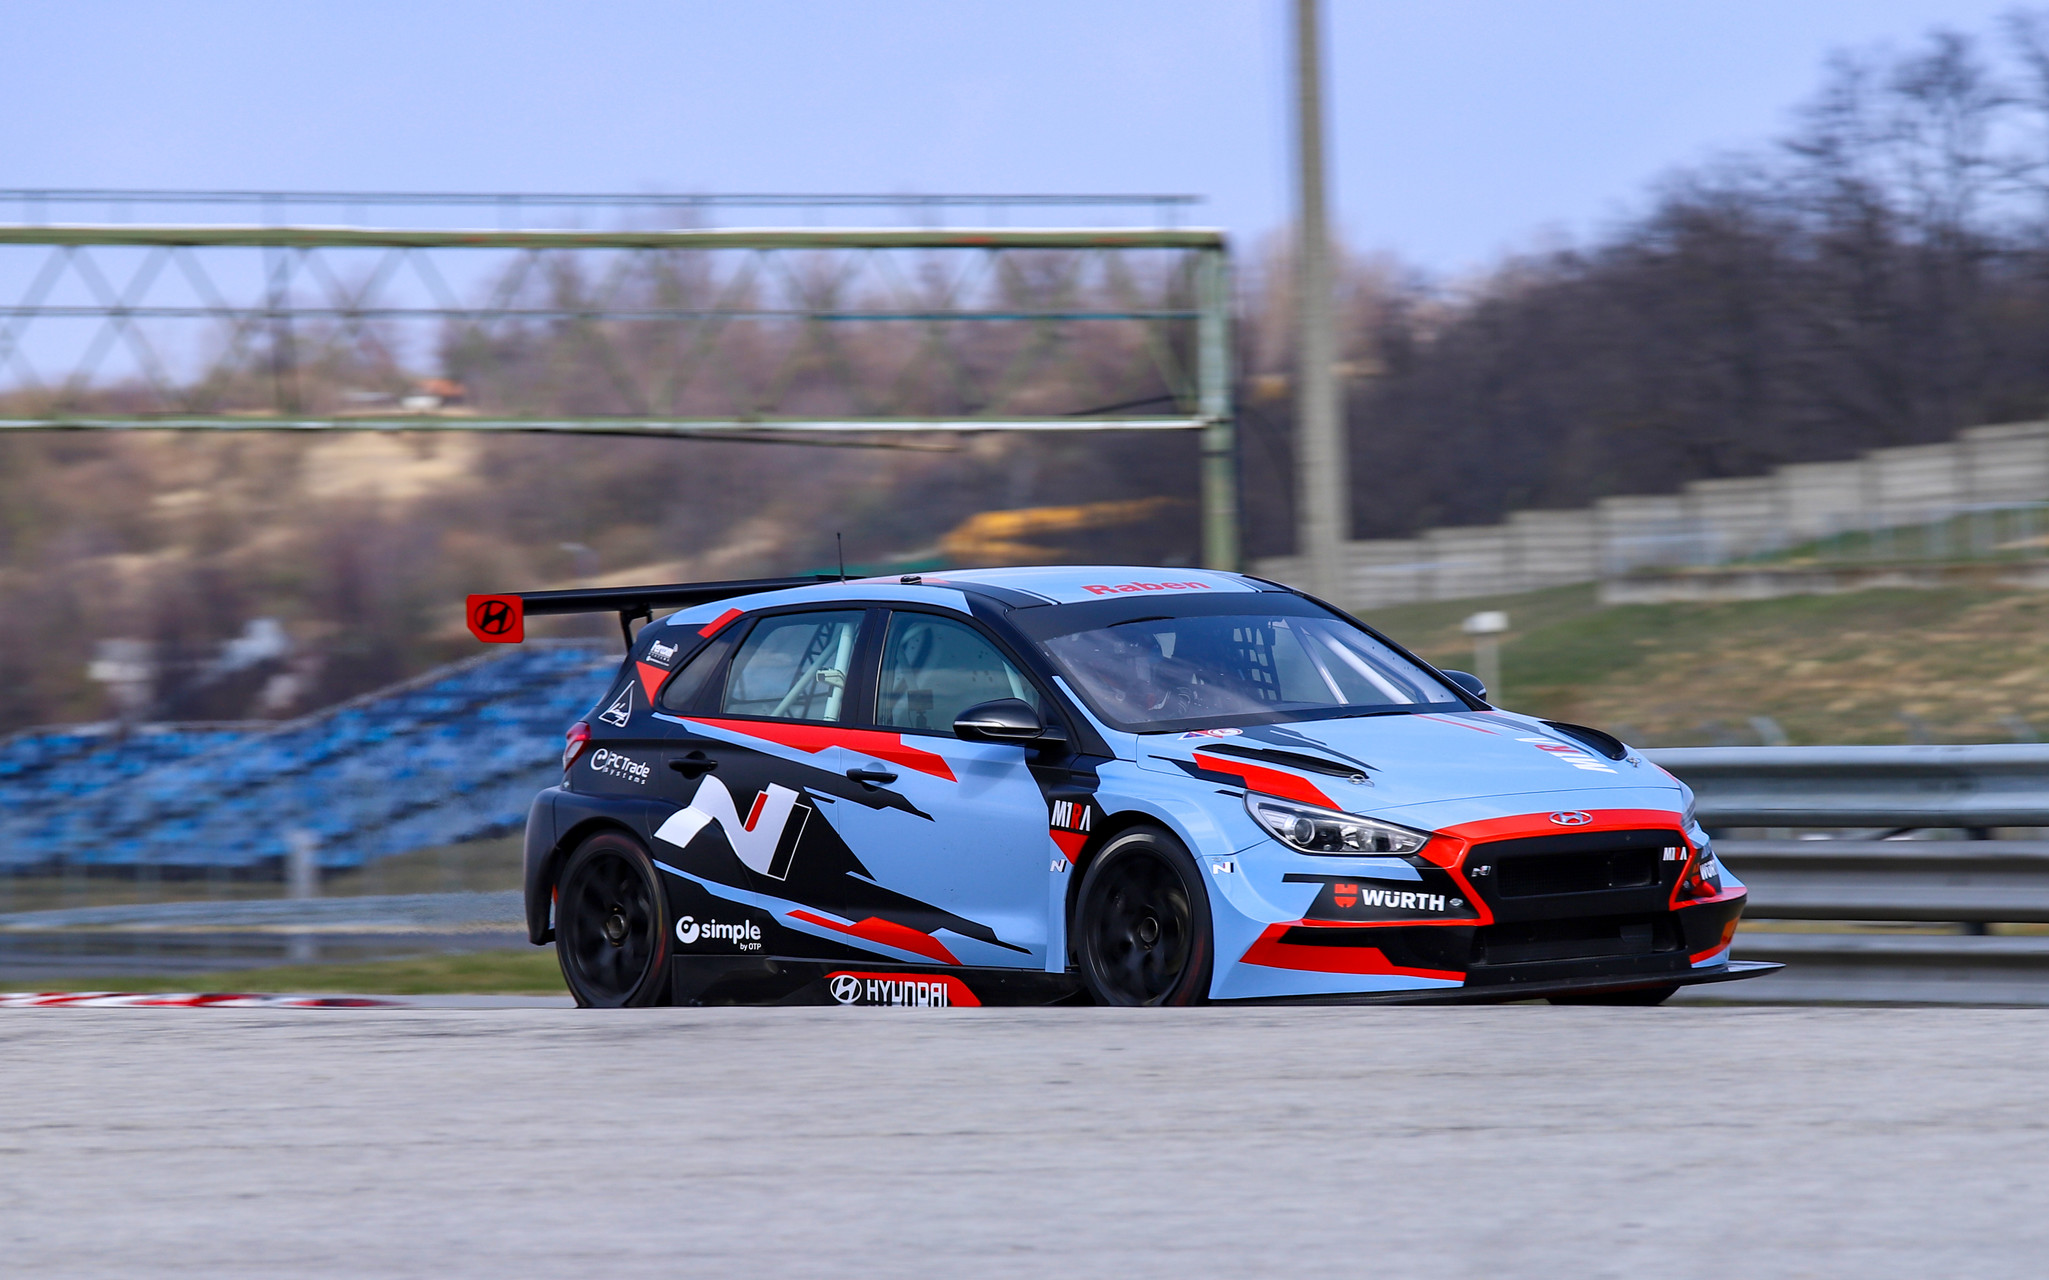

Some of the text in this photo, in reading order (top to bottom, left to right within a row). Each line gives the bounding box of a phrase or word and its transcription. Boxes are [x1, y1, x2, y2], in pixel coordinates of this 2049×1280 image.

[1081, 581, 1211, 595] Raben
[653, 774, 812, 881] N
[1361, 889, 1446, 912] WÜRTH
[701, 918, 762, 945] simple
[739, 942, 762, 952] by OTP
[866, 979, 948, 1007] HYUNDAI
